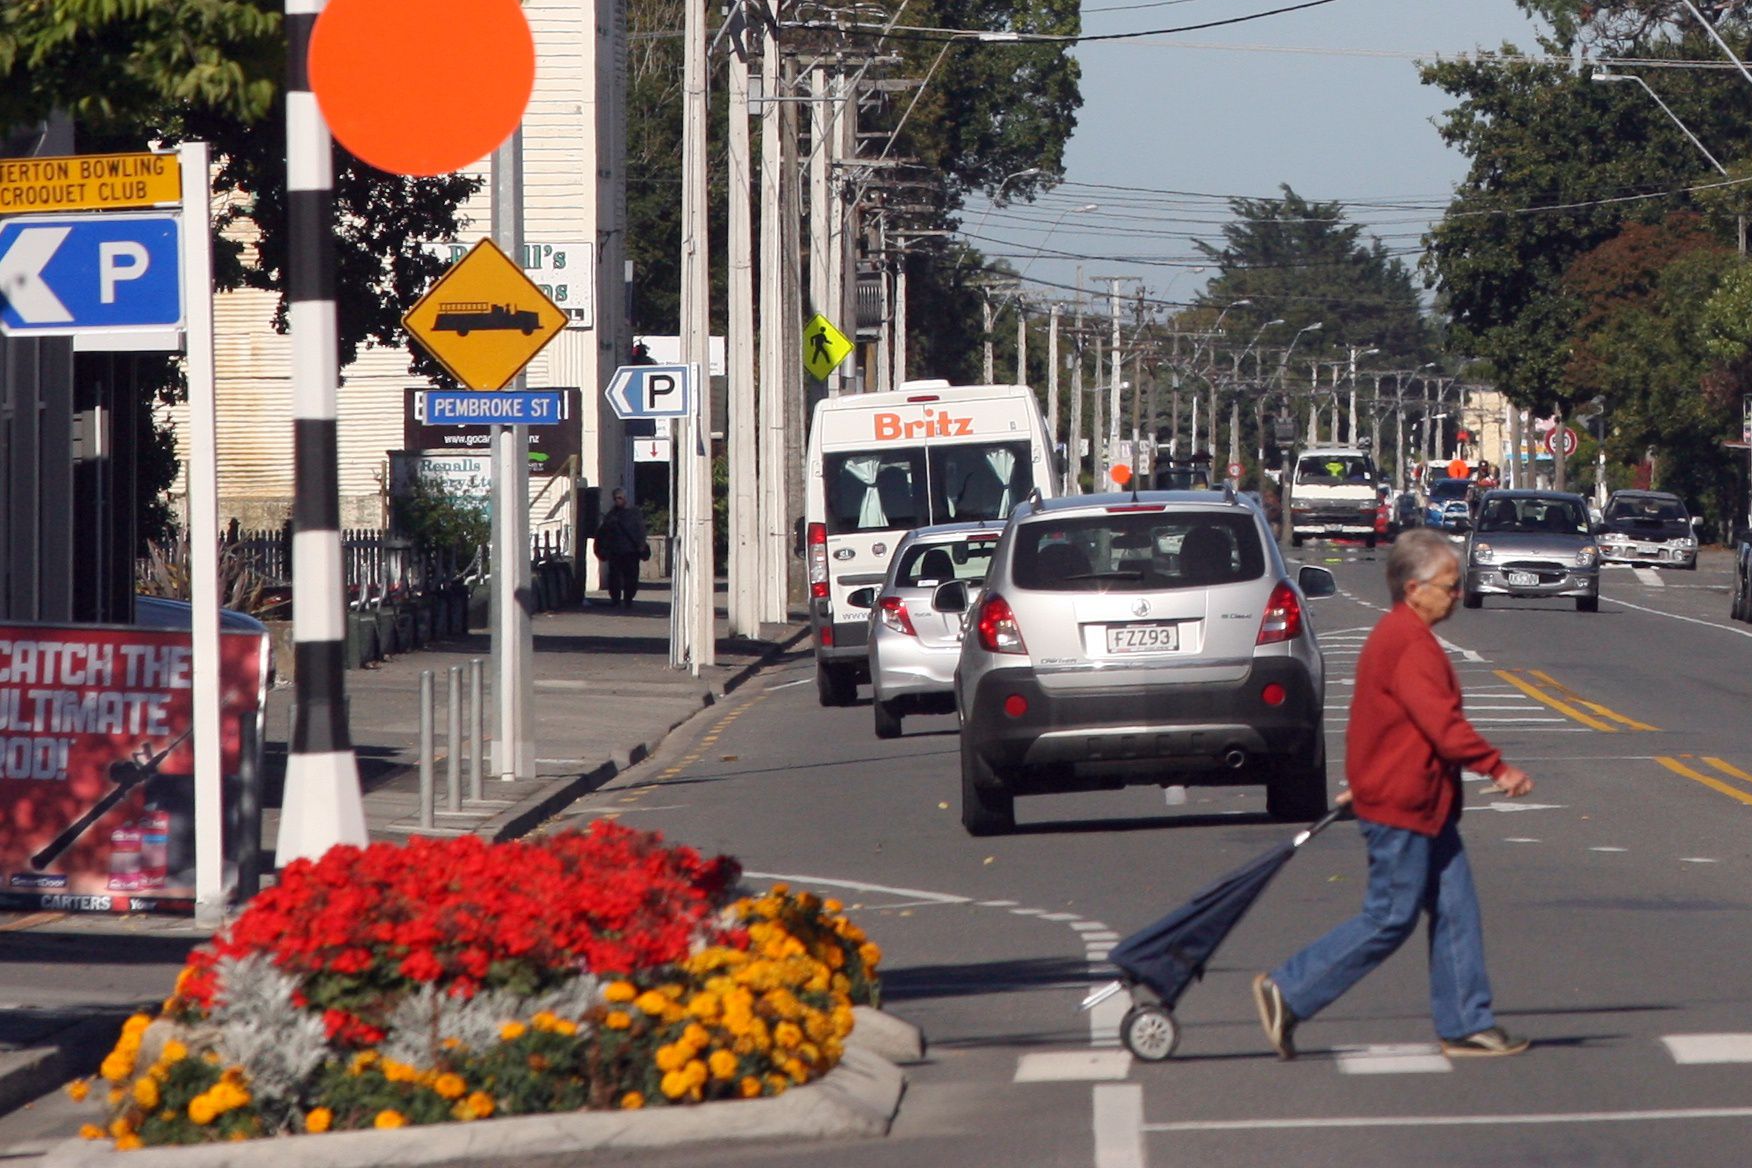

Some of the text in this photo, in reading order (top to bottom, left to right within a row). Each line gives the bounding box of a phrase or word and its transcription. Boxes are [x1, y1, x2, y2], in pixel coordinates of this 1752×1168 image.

[79, 157, 165, 180] BOWLING
[1, 181, 148, 206] CROQUET CLUB
[99, 241, 149, 304] P
[649, 374, 675, 409] P
[434, 397, 524, 418] PEMBROKE
[530, 398, 551, 417] ST
[874, 409, 974, 441] Britz
[1114, 629, 1171, 648] FZZ93
[120, 643, 193, 689] THE
[40, 895, 111, 911] CARTERS
